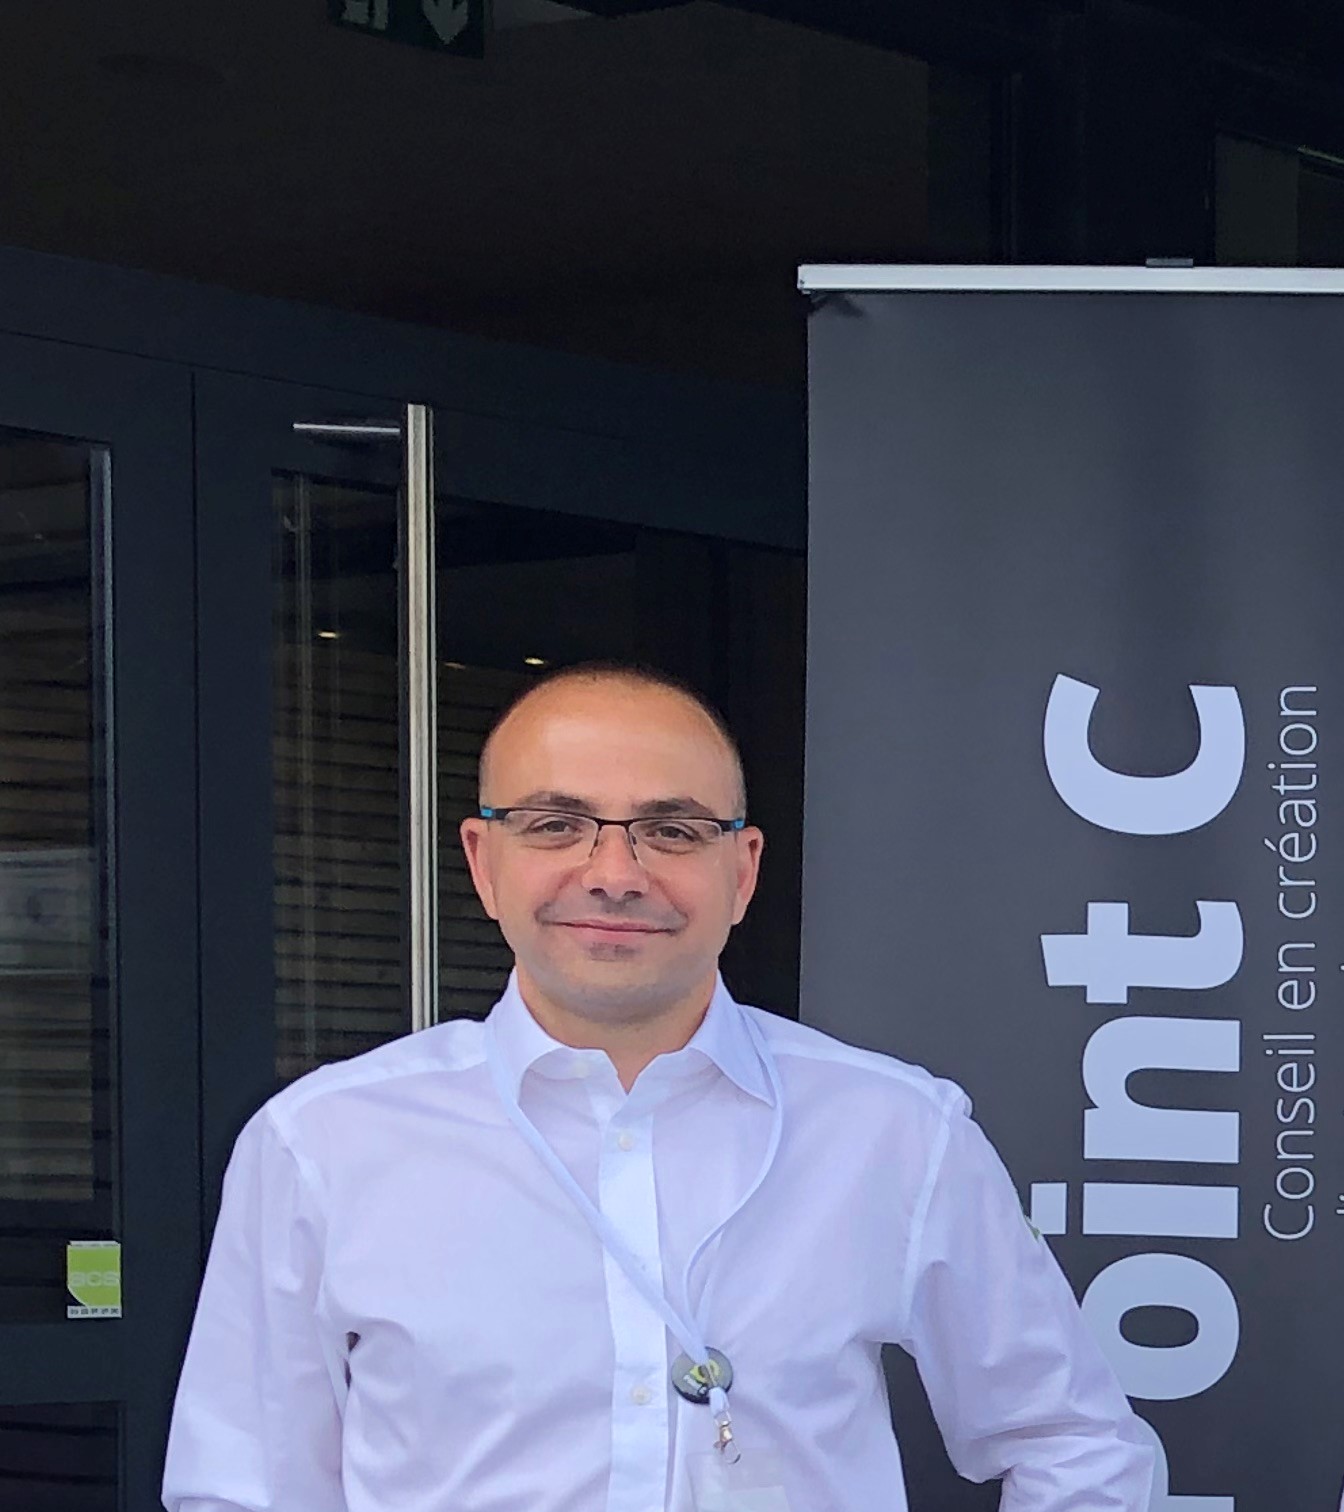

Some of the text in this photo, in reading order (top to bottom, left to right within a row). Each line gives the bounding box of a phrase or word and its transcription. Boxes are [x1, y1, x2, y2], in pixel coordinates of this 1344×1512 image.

[1262, 685, 1319, 1241] Conseil en création
